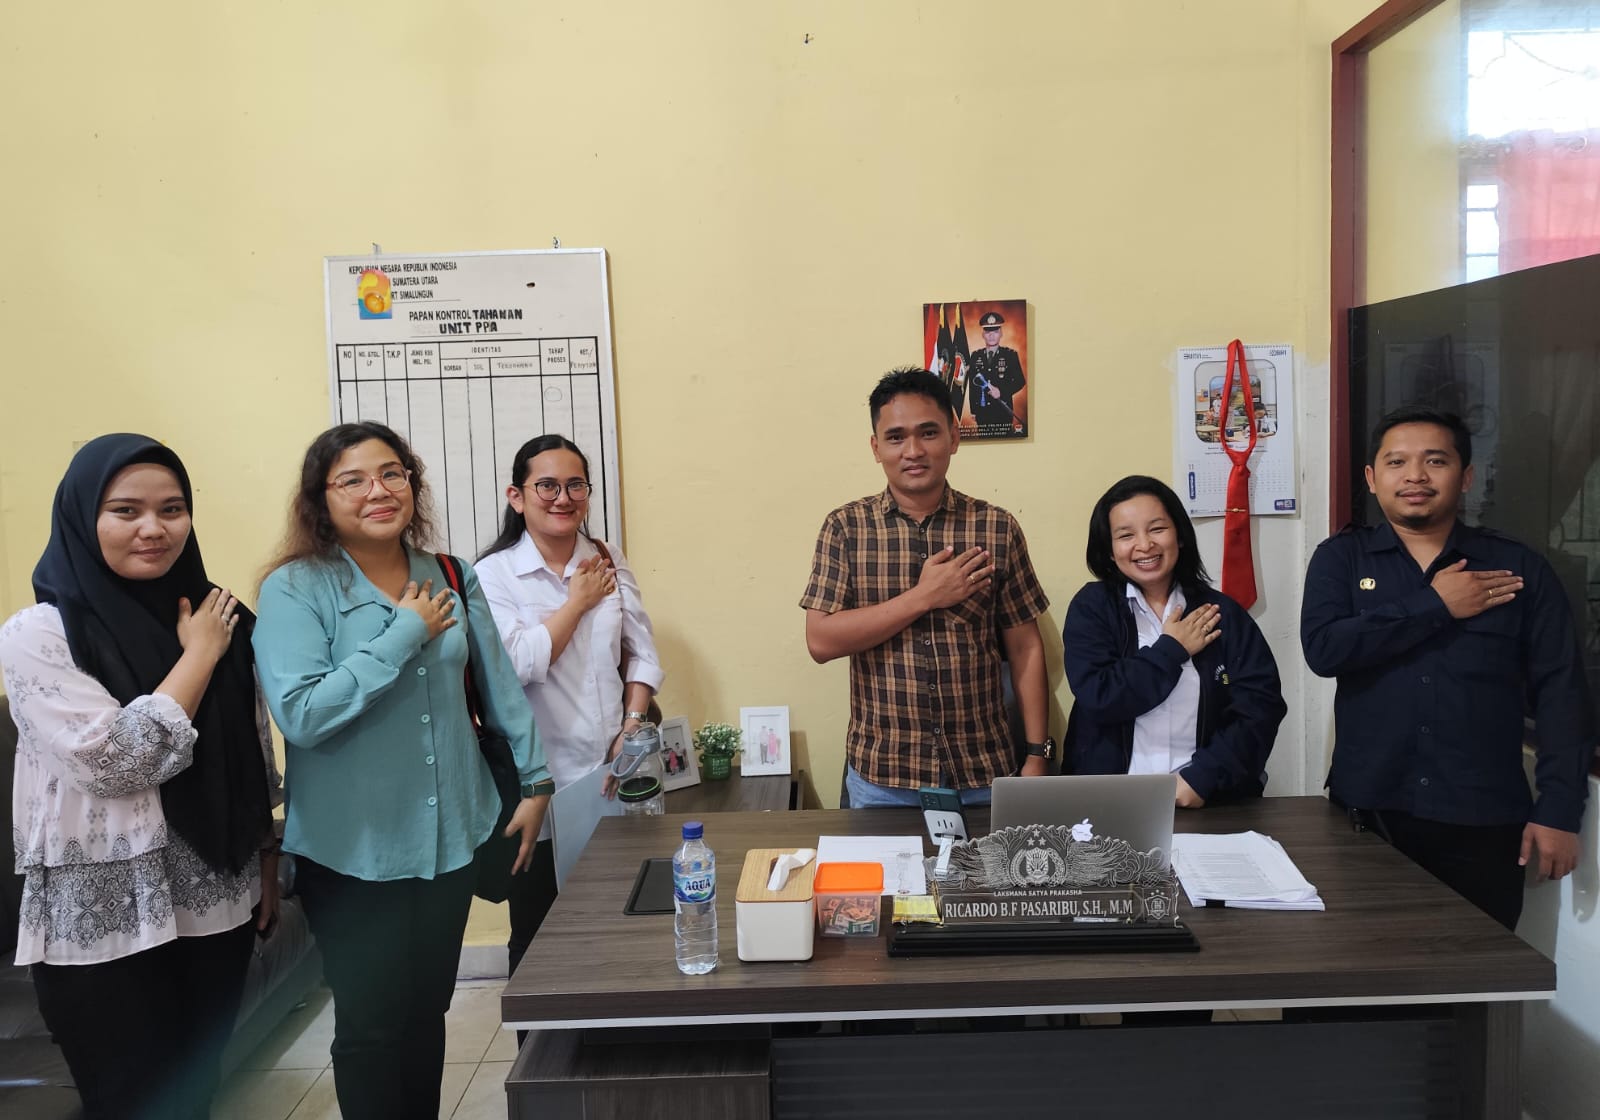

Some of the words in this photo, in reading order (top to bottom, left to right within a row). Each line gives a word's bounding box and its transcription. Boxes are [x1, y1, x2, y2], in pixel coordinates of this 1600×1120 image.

[380, 264, 402, 273] NEGARA
[403, 262, 428, 273] REPUBLIK
[430, 261, 458, 271] INDONESIA
[392, 277, 420, 286] SUMATERA
[421, 276, 438, 285] UTARA
[399, 290, 434, 299] SIMALUNGUN
[409, 311, 434, 320] PAPAN
[436, 310, 472, 320] KONTROL
[472, 309, 523, 320] TAHANAN
[439, 322, 471, 334] UNIT
[475, 321, 498, 333] PPA
[471, 346, 502, 354] IDENTITAS
[685, 878, 711, 891] AQUA
[1028, 889, 1048, 897] SATYA
[1049, 889, 1082, 897] PRAKASHA
[945, 902, 998, 918] RICARDO
[1000, 902, 1019, 917] B.F
[1021, 901, 1081, 917] PASARIBU,
[1083, 900, 1107, 917] S.H.,
[1109, 900, 1133, 914] M.M
